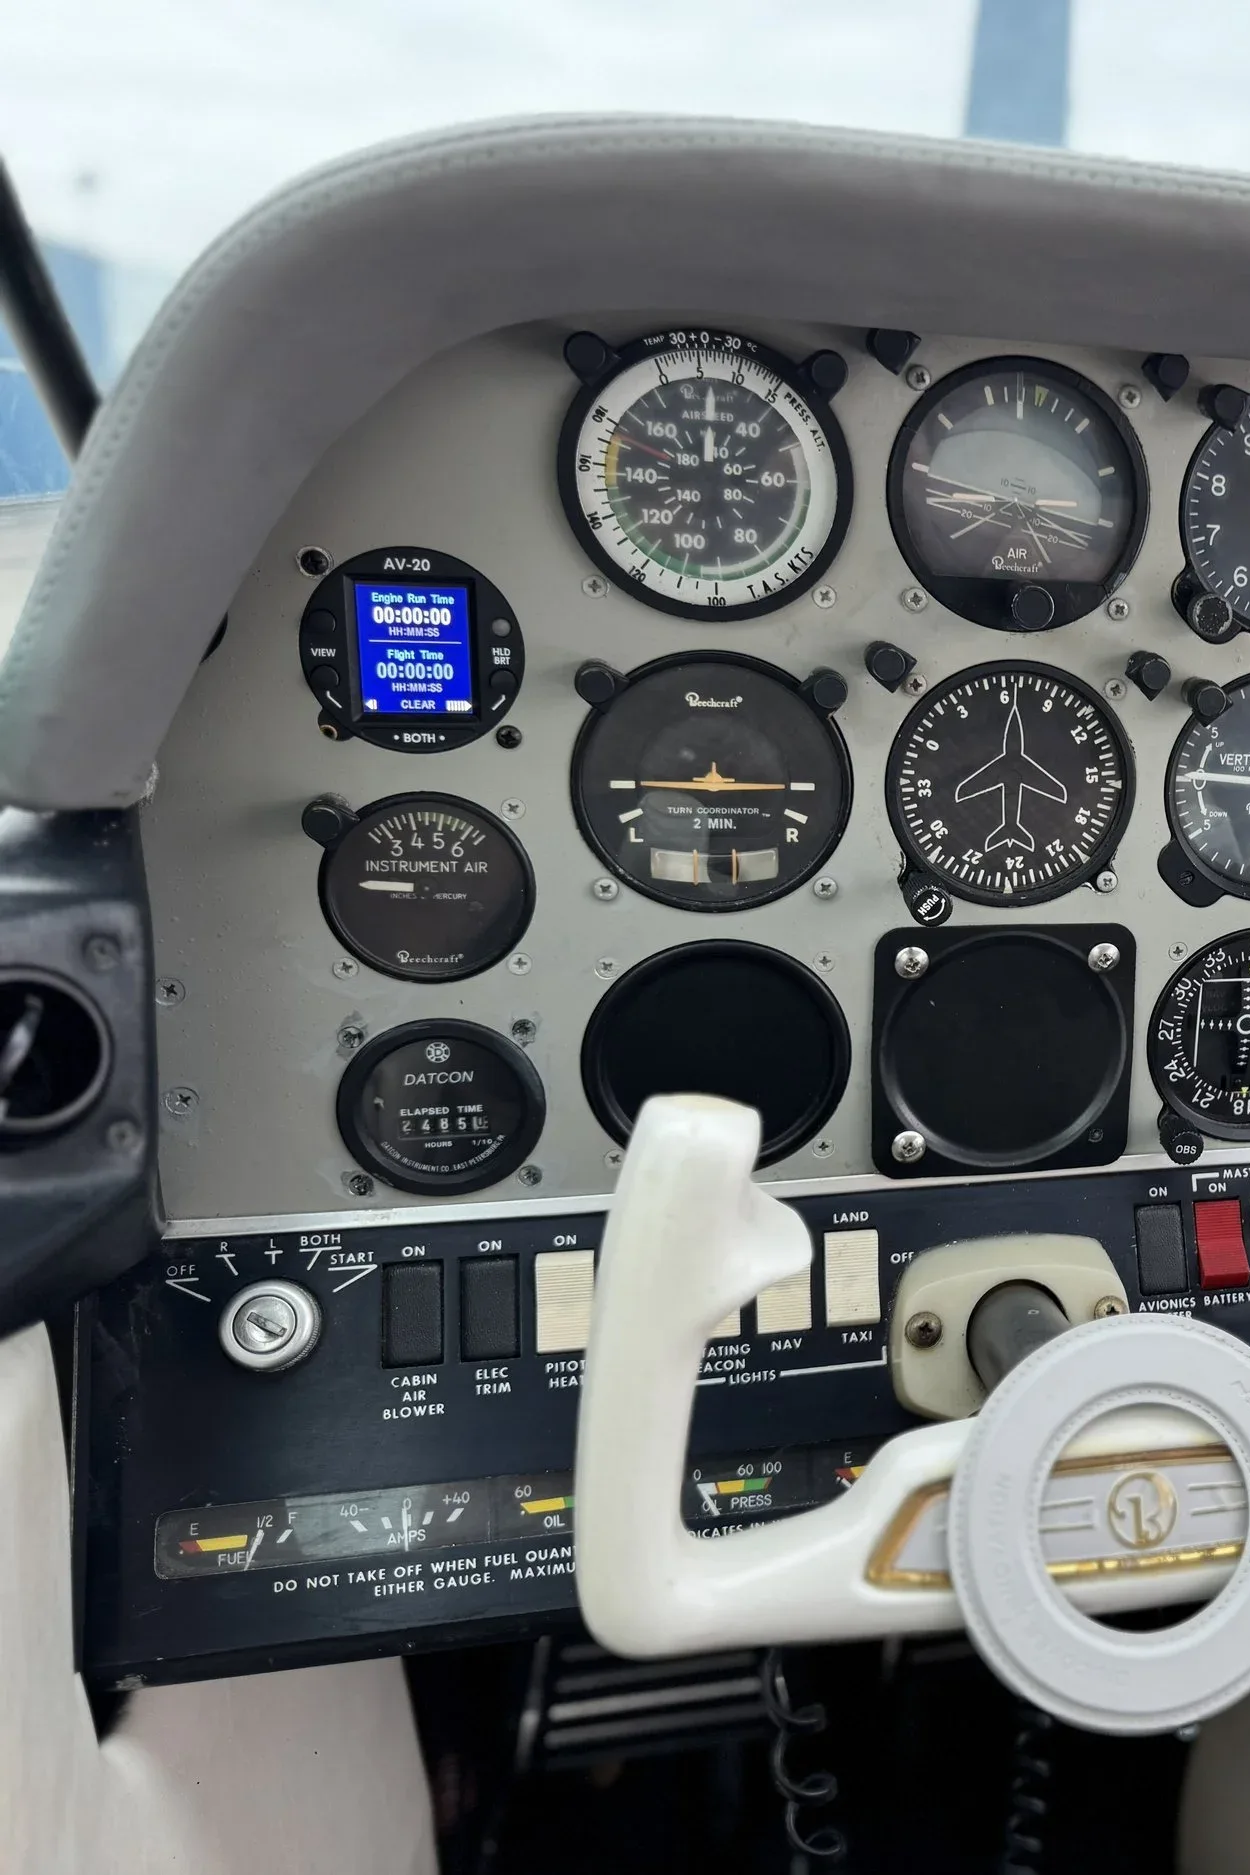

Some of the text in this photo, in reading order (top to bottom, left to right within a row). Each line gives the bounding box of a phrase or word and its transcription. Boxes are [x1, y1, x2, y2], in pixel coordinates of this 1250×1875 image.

[643, 335, 665, 346] TEMP
[669, 332, 686, 344] 30
[725, 334, 741, 349] 30
[784, 392, 825, 452] PRESS. ALT.
[646, 423, 677, 438] 160
[625, 468, 657, 483] 140
[642, 509, 673, 524] 120
[675, 534, 705, 549] 100
[1008, 549, 1027, 559] AIR
[384, 559, 430, 571] AV-20
[788, 548, 813, 574] KTS
[992, 556, 1040, 573] Beechcraft
[371, 592, 454, 605] Engine Run Time
[373, 607, 451, 625] 00:00:00
[389, 627, 440, 637] HH:MM:SS
[311, 648, 336, 657] VIEW
[387, 650, 443, 661] Flight Time
[492, 648, 511, 656] HLD
[494, 656, 510, 665] BRT
[376, 663, 453, 679] 00:00:00
[392, 683, 442, 692] HH:MM:SS
[401, 700, 435, 709] CLEAR
[685, 691, 738, 708] Beechcraft
[403, 733, 436, 743] BOTH
[694, 819, 736, 829] 2 MIN.
[630, 828, 643, 842] L
[786, 828, 798, 842] R
[366, 861, 487, 873] INSTRUMENT AIR
[918, 894, 939, 916] PUSH
[398, 951, 460, 963] Beechcraft
[404, 1071, 474, 1085] DATCON
[401, 1104, 483, 1116] ELAPSED TIME
[1176, 1145, 1196, 1154] OBS
[1149, 1186, 1167, 1197] ON
[1209, 1182, 1227, 1193] ON
[833, 1211, 869, 1223] LAND
[221, 1242, 228, 1251] R
[271, 1239, 276, 1248] L
[301, 1234, 341, 1246] BOTH
[478, 1241, 502, 1252] ON
[554, 1234, 577, 1246] ON
[331, 1252, 374, 1264] START
[402, 1246, 425, 1257] ON
[167, 1264, 196, 1277] OFF
[1139, 1297, 1196, 1313] AVIONICS
[842, 1331, 872, 1344] TAXI
[771, 1338, 802, 1351] NAV
[475, 1368, 509, 1379] ELEC
[729, 1370, 776, 1385] LIGHTS
[391, 1374, 437, 1387] CABIN
[476, 1382, 511, 1394] TRIM
[403, 1389, 426, 1401] AIR
[383, 1404, 444, 1419] BLOWER
[738, 1464, 753, 1476] 60
[763, 1462, 782, 1474] 100
[442, 1491, 470, 1504] +40
[514, 1485, 532, 1498] 60
[731, 1494, 772, 1509] PRESS
[256, 1515, 273, 1528] 1/2
[288, 1512, 297, 1525] F
[544, 1515, 566, 1529] OIL
[387, 1529, 426, 1545] AMPS
[218, 1551, 255, 1566] FUEL
[273, 1579, 294, 1593] DO
[306, 1574, 339, 1590] NOT
[347, 1568, 386, 1584] TAKE
[394, 1563, 423, 1578] OFF
[430, 1557, 477, 1574] WHEN
[484, 1551, 519, 1566] FUEL
[374, 1579, 425, 1597] EITHER
[435, 1571, 497, 1590] GAUGE.
